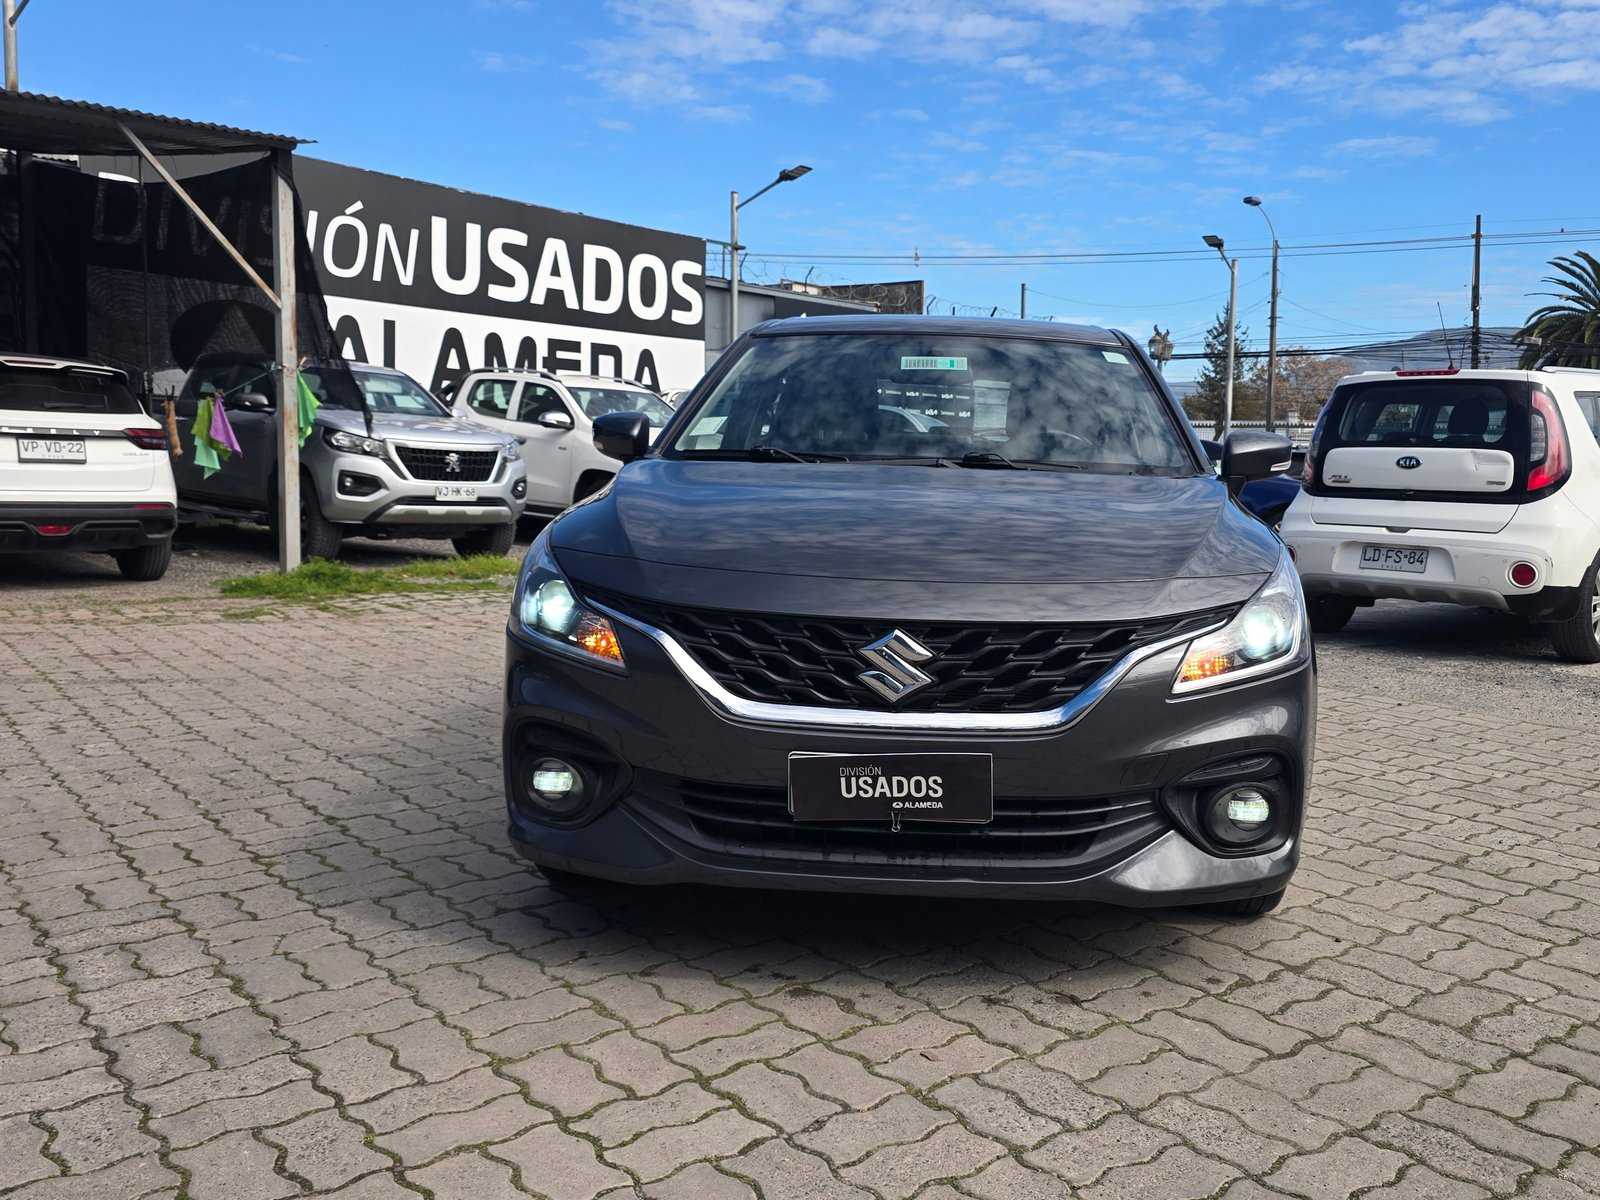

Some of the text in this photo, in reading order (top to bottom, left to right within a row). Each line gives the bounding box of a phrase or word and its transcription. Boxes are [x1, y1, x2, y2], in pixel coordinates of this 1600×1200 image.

[431, 215, 703, 326] USADOS
[1399, 458, 1417, 467] KIA
[839, 765, 882, 776] DIVISIÓN
[840, 775, 943, 799] USADOS
[904, 801, 943, 809] ALAMEDA
